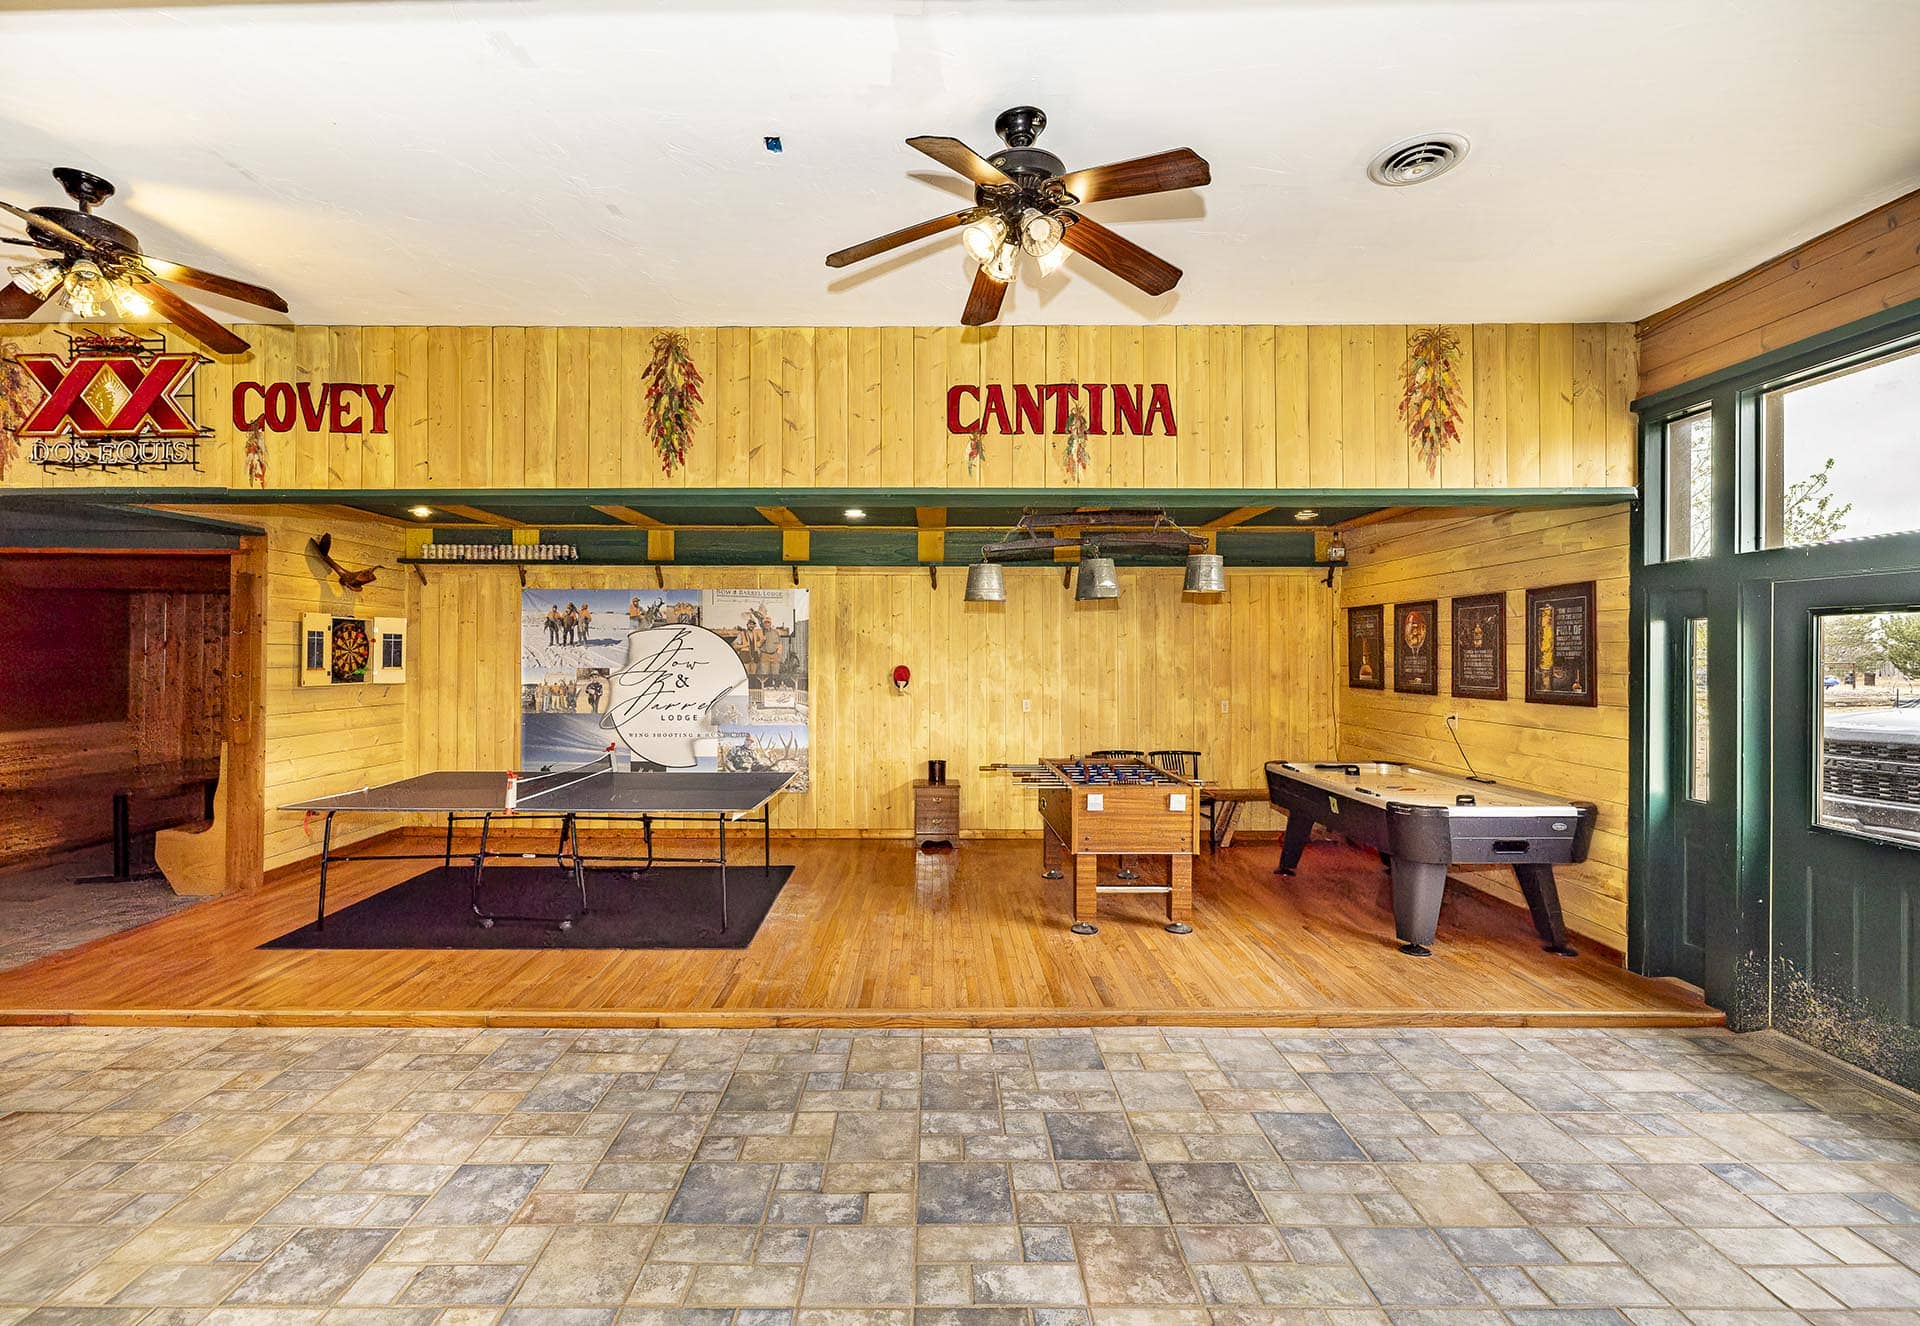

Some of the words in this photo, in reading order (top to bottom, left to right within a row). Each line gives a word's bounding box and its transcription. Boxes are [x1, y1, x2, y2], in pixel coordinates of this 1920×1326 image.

[232, 381, 394, 434] COVEY
[947, 383, 1177, 436] CANTINA
[28, 440, 90, 464] DOS
[97, 440, 188, 464] EQUIS
[619, 628, 710, 686] Bow
[675, 673, 690, 689] &
[600, 670, 747, 729] Barrel
